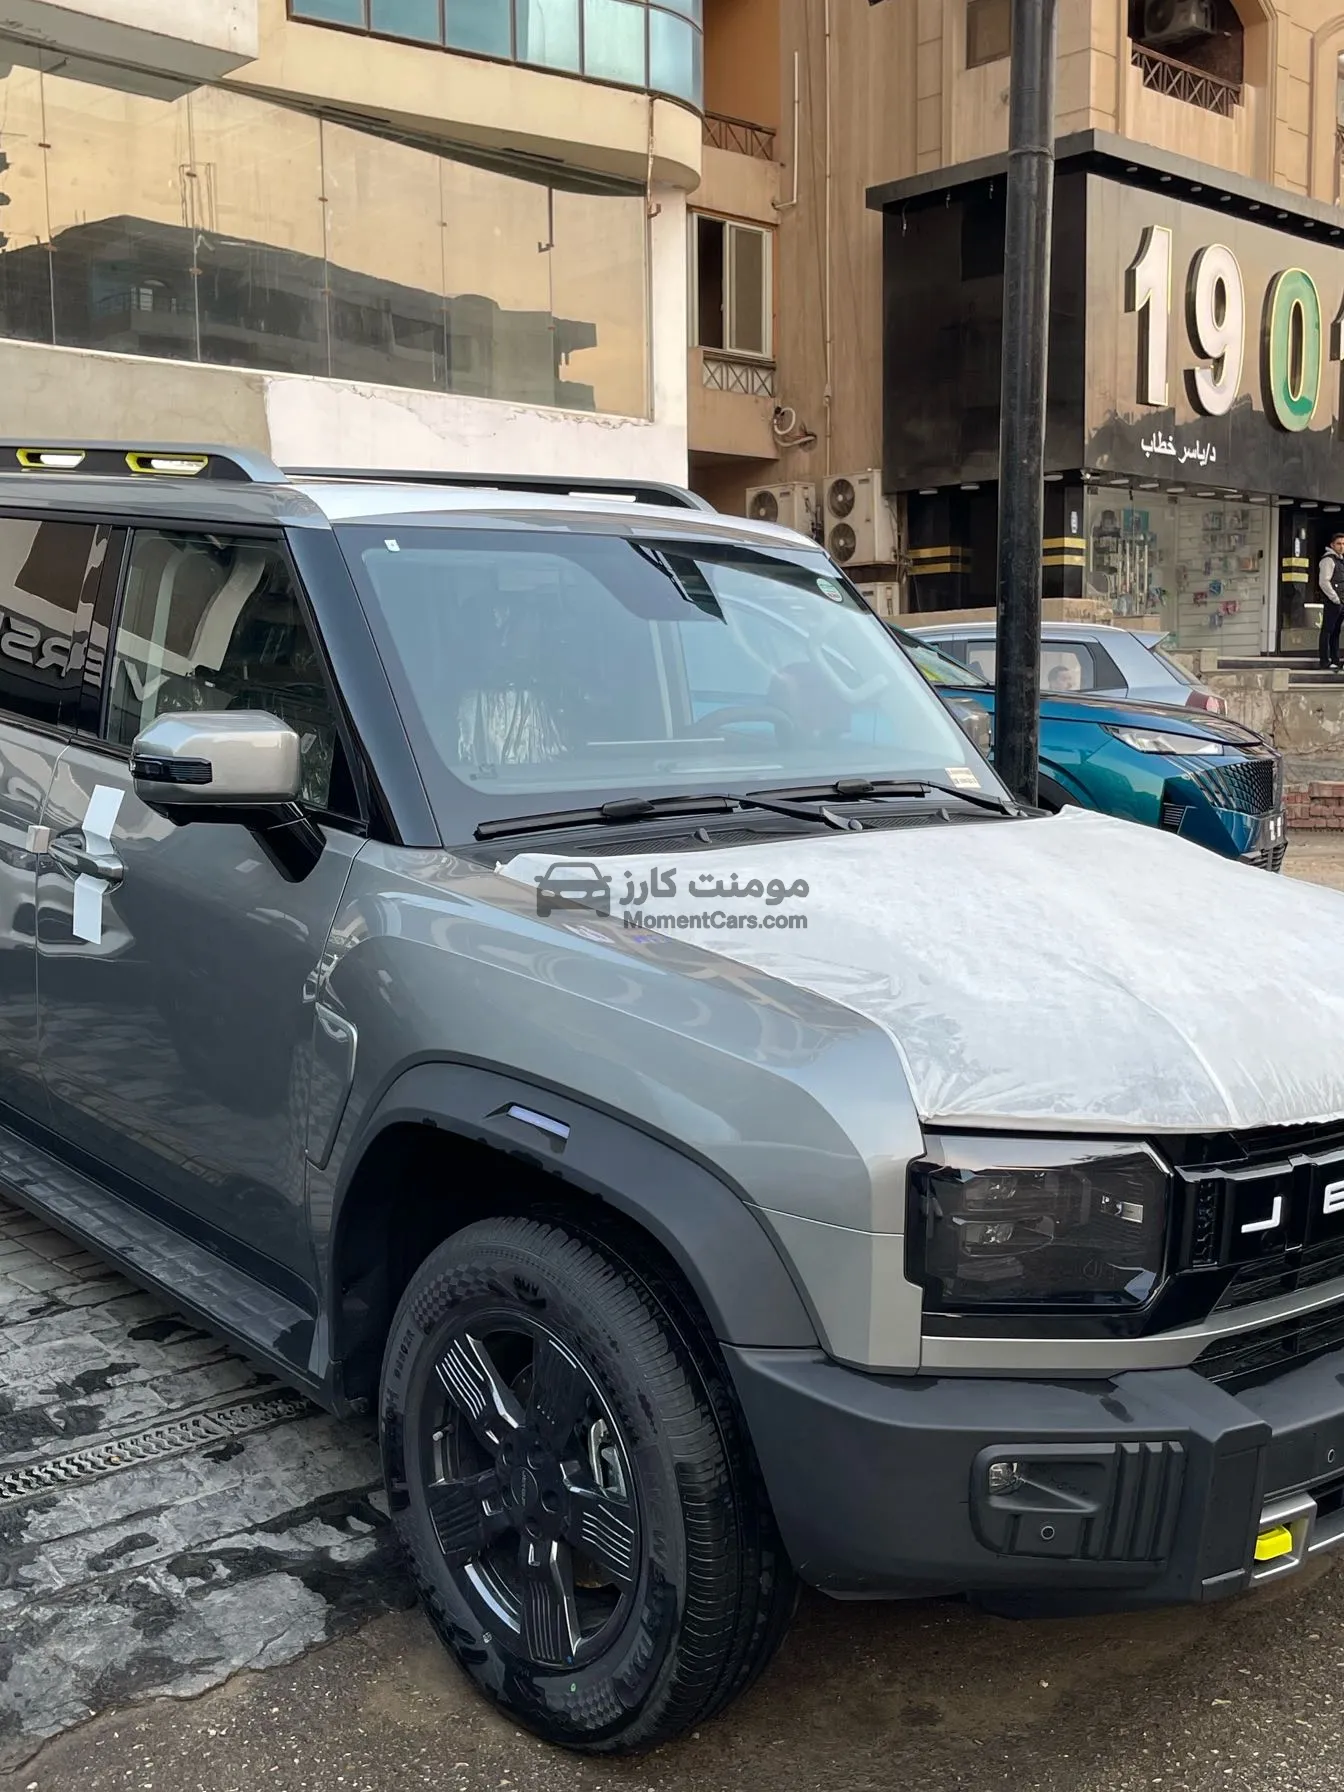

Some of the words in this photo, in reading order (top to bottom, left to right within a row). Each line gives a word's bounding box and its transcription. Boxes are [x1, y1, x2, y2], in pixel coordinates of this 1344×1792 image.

[1124, 224, 1344, 440] 190
[1141, 431, 1177, 458] خطاب
[1178, 440, 1217, 466] د/ياسر
